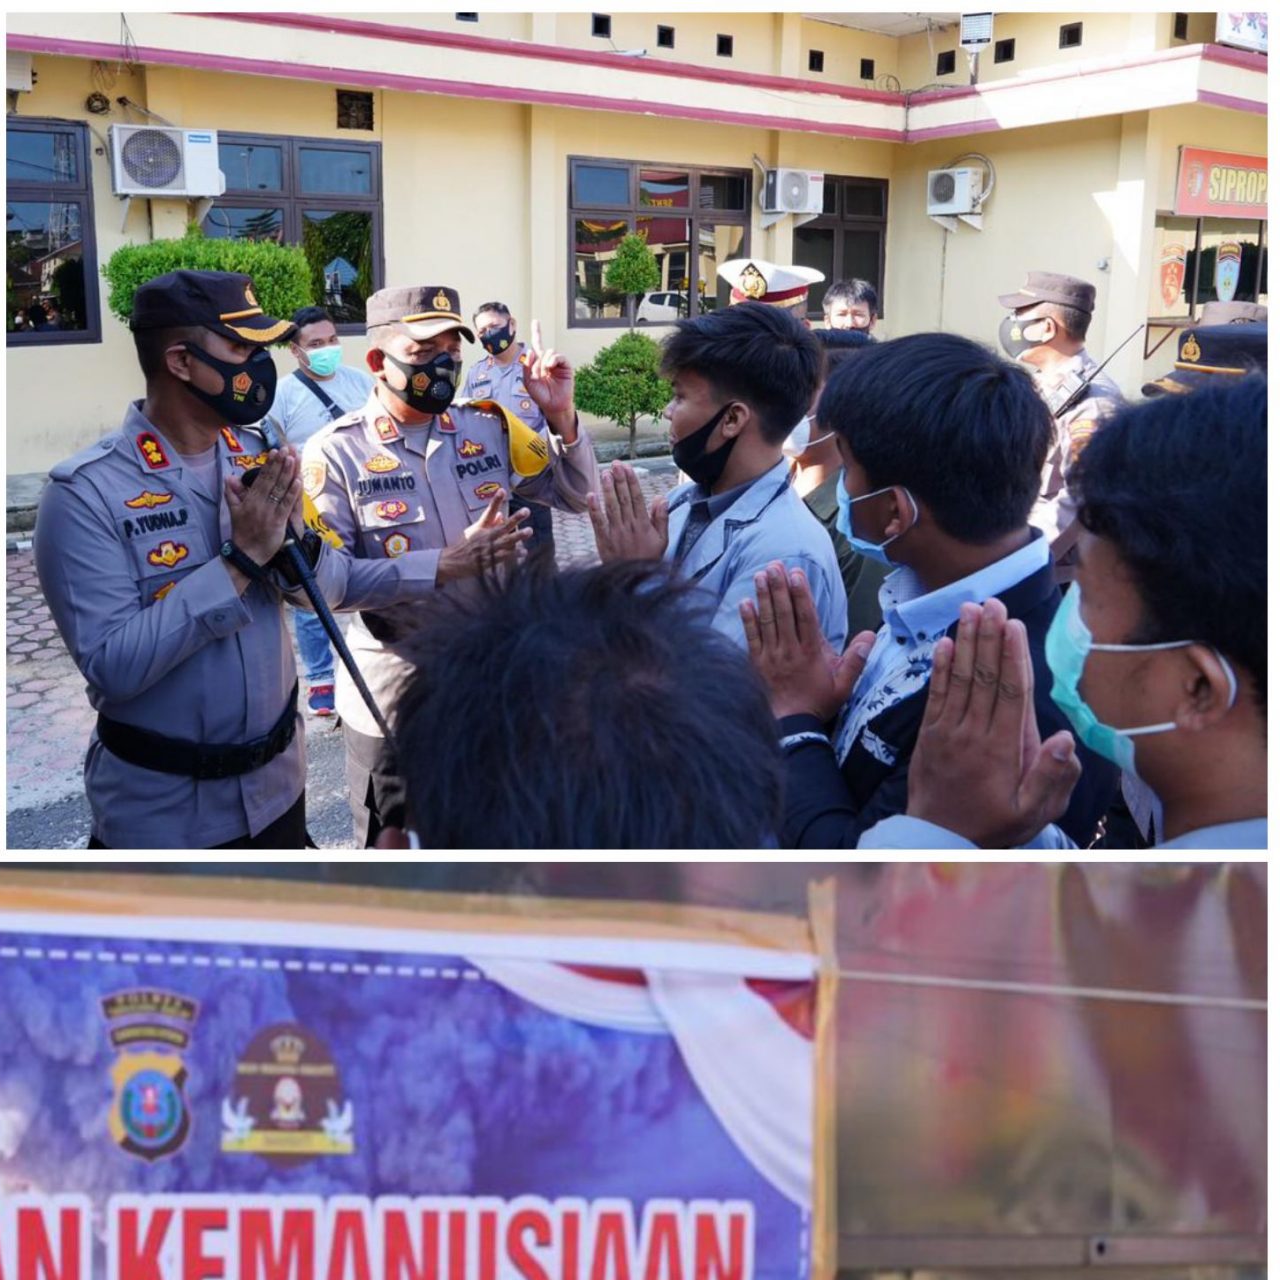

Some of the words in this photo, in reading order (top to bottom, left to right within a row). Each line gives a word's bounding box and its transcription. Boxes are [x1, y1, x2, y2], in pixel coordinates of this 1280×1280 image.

[1208, 166, 1268, 204] SIPROP
[456, 454, 502, 480] POLRI
[357, 475, 416, 497] JUMANTO
